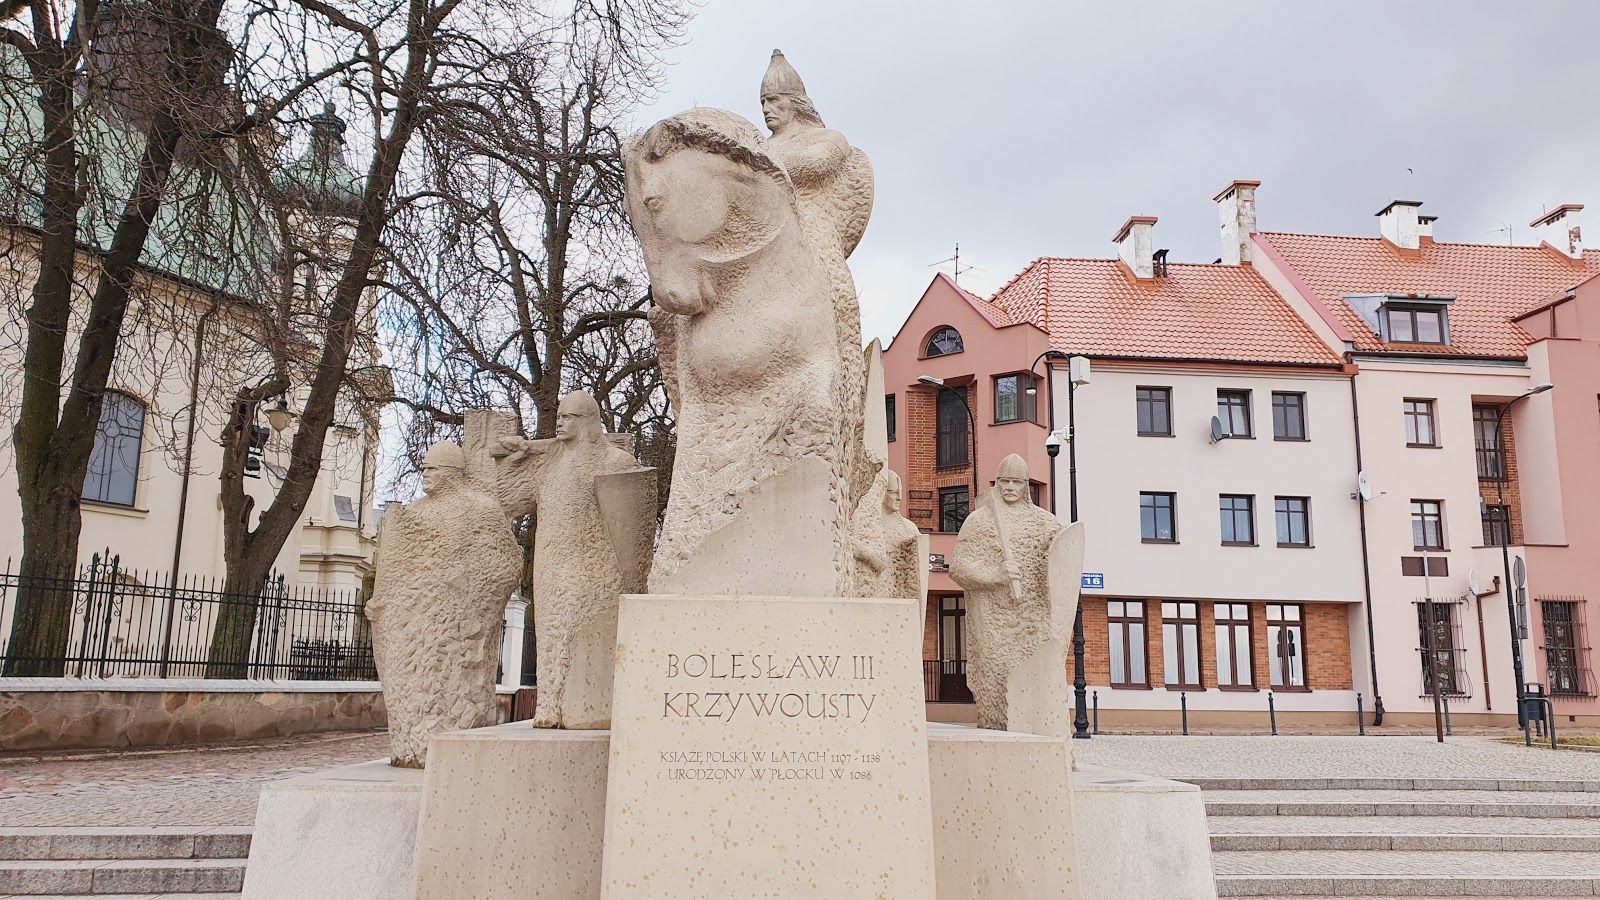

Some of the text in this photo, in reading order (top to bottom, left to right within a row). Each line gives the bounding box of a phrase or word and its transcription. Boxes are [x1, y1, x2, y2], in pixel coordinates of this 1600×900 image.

[1084, 577, 1101, 585] 16
[666, 653, 875, 680] BOLESŁAW III
[662, 692, 876, 724] KRZYWOUSTY
[706, 751, 747, 763] POLSKI
[751, 751, 766, 763] W
[771, 751, 826, 763] LATACH
[831, 754, 852, 763] 1107
[861, 754, 881, 763] 1138
[668, 768, 872, 781] URODZONY W PŁOCKU W 1086
